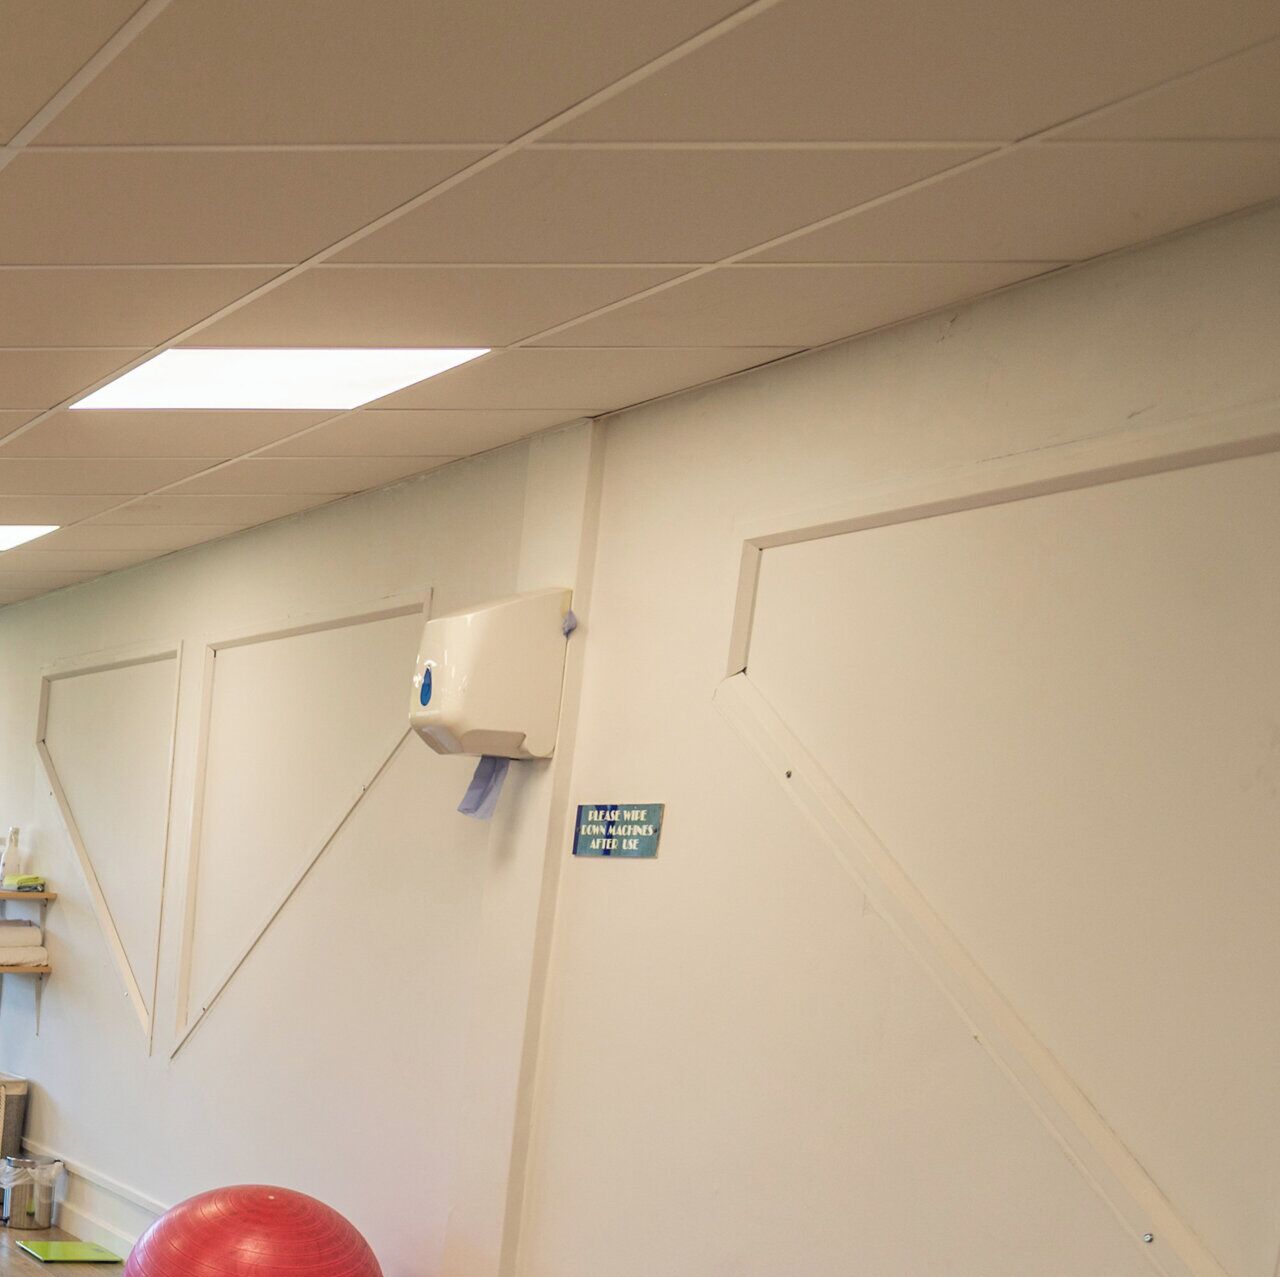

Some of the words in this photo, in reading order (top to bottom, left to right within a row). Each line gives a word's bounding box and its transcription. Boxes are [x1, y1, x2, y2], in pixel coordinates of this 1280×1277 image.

[588, 809, 621, 821] PLEASE
[623, 809, 647, 821] WIPE
[581, 824, 606, 835] DOWN
[607, 824, 654, 836] MACHINES
[590, 838, 618, 850] AFTER
[622, 838, 640, 850] USE
